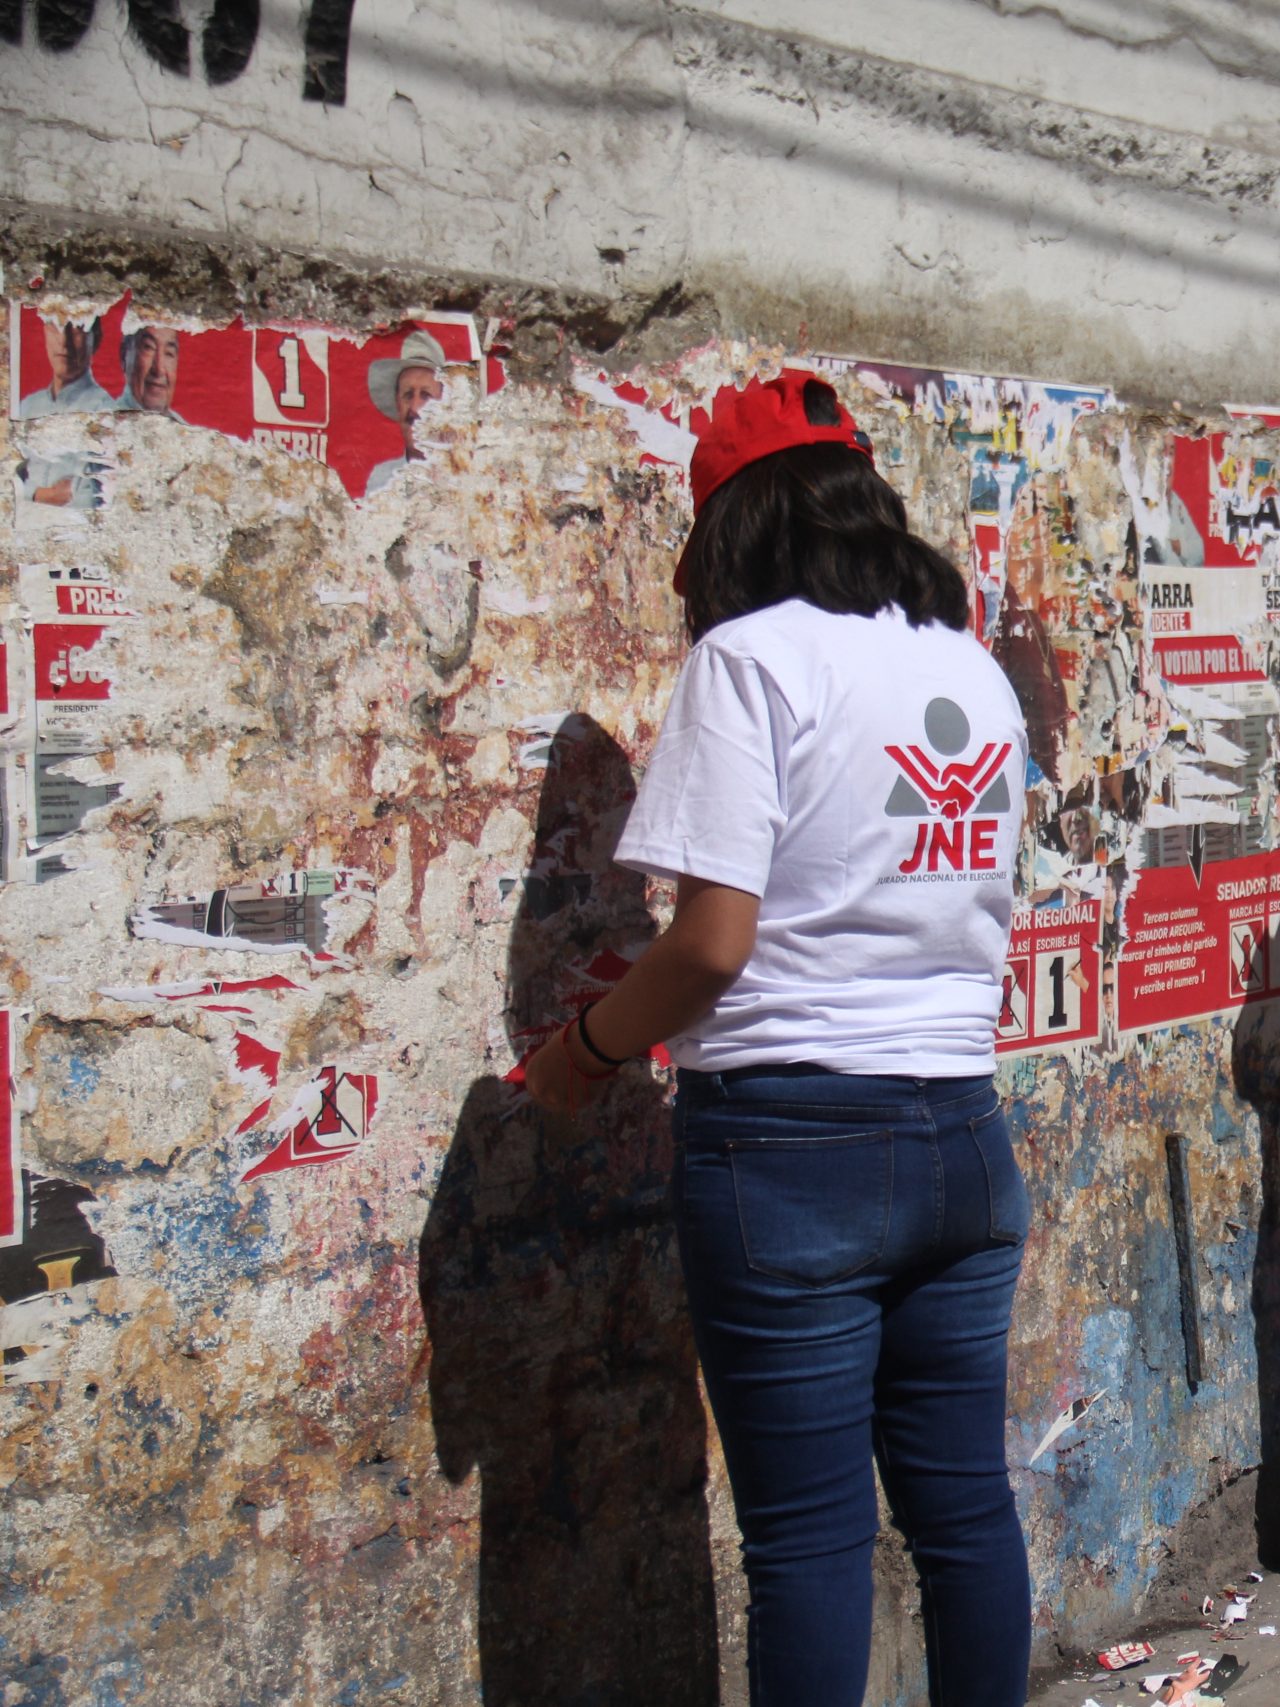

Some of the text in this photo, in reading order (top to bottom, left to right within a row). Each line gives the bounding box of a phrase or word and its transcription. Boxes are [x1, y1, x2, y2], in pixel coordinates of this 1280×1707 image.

[278, 337, 305, 409] 1
[1164, 650, 1202, 676] VOTAR
[1203, 648, 1227, 674] POR
[1228, 647, 1240, 672] EL
[899, 820, 998, 874] JNE
[876, 872, 1007, 886] JURADO NACIONAL DE ELECCIONES
[1216, 877, 1268, 902] SENADOR
[1034, 904, 1096, 929] REGIONAL
[1143, 907, 1199, 925] Tercera columna
[1229, 905, 1253, 920] MARCA
[1017, 937, 1030, 954] ASÍ
[1036, 936, 1066, 951] ESCRIBE
[1068, 932, 1080, 947] ASÍ
[1134, 921, 1206, 943] SENADOR AREQUIPA:
[1122, 950, 1145, 962] marcar
[1146, 946, 1153, 959] el
[1183, 939, 1193, 953] del
[1193, 936, 1218, 954] partido
[1144, 956, 1197, 977] PERU PRIMERO
[1048, 956, 1067, 1029] 1
[1134, 987, 1140, 1000] y
[1140, 980, 1166, 995] escribe
[1166, 977, 1173, 990] el
[1201, 969, 1206, 984] 1
